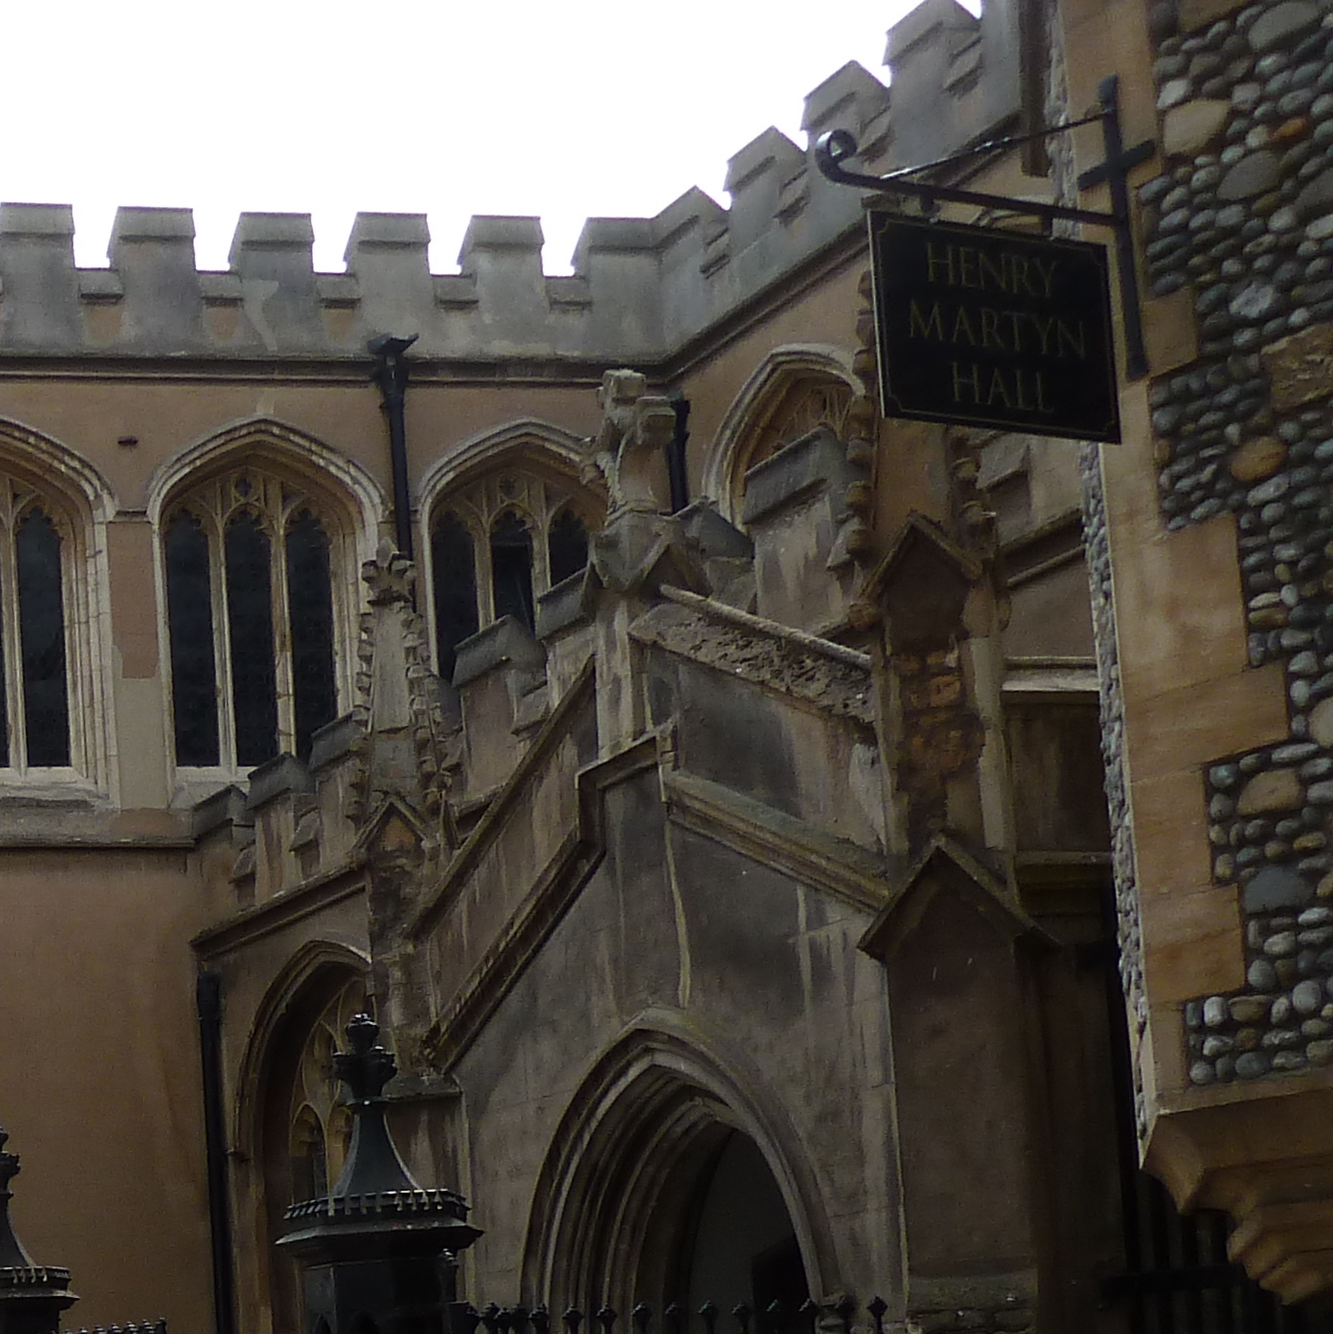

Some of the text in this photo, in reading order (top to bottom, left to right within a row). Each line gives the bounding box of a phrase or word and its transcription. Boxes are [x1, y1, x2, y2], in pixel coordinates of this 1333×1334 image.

[926, 241, 1058, 299] HENRY
[909, 298, 1087, 360] MARTYN
[951, 361, 1055, 413] HALL
